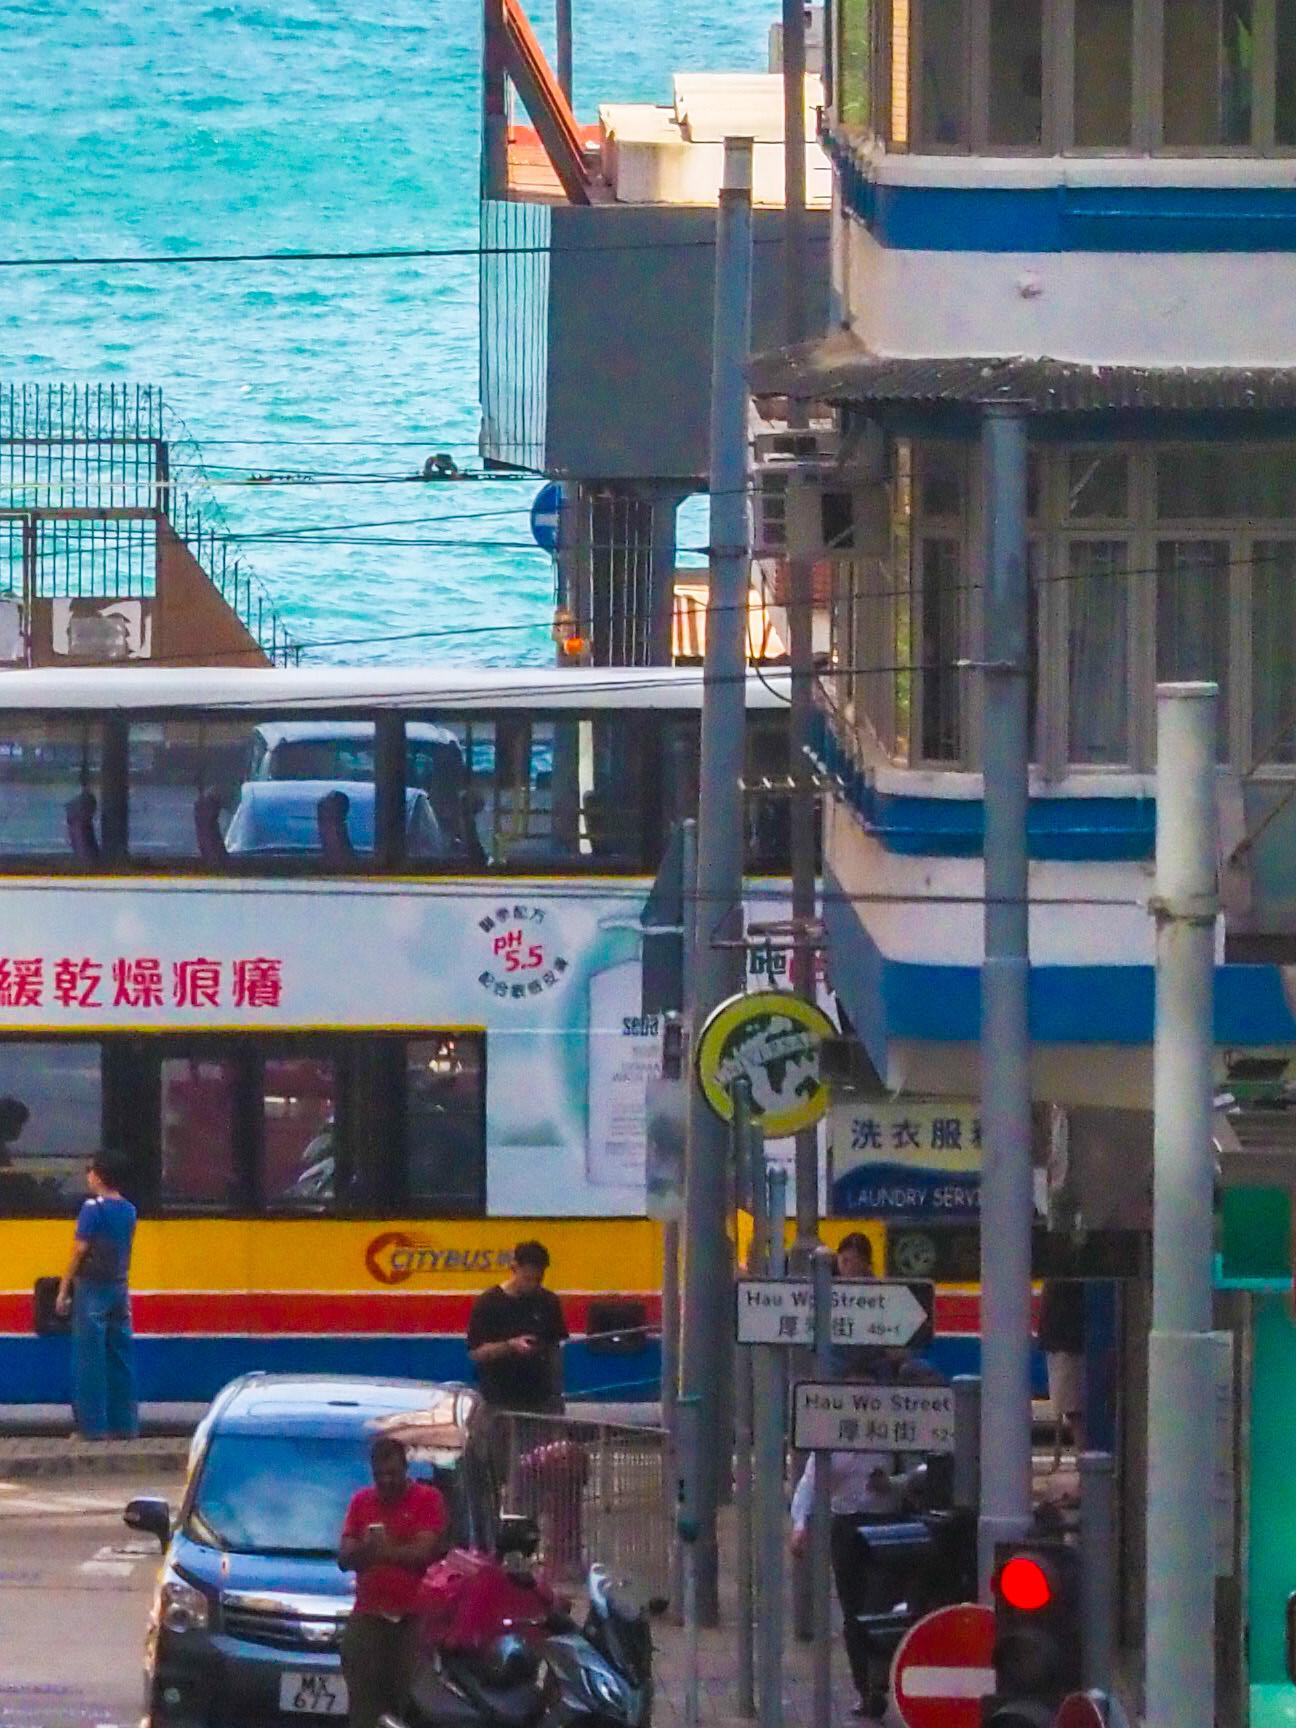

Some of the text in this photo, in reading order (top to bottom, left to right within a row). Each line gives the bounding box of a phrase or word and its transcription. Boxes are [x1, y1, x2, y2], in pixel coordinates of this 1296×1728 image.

[494, 929, 522, 955] pH
[505, 944, 543, 972] 5.5
[848, 1187, 981, 1208] LAUNDRY SERV
[390, 1248, 492, 1270] CITYBUS
[747, 1291, 782, 1307] Hau
[806, 1393, 951, 1412] Hau Wo Street
